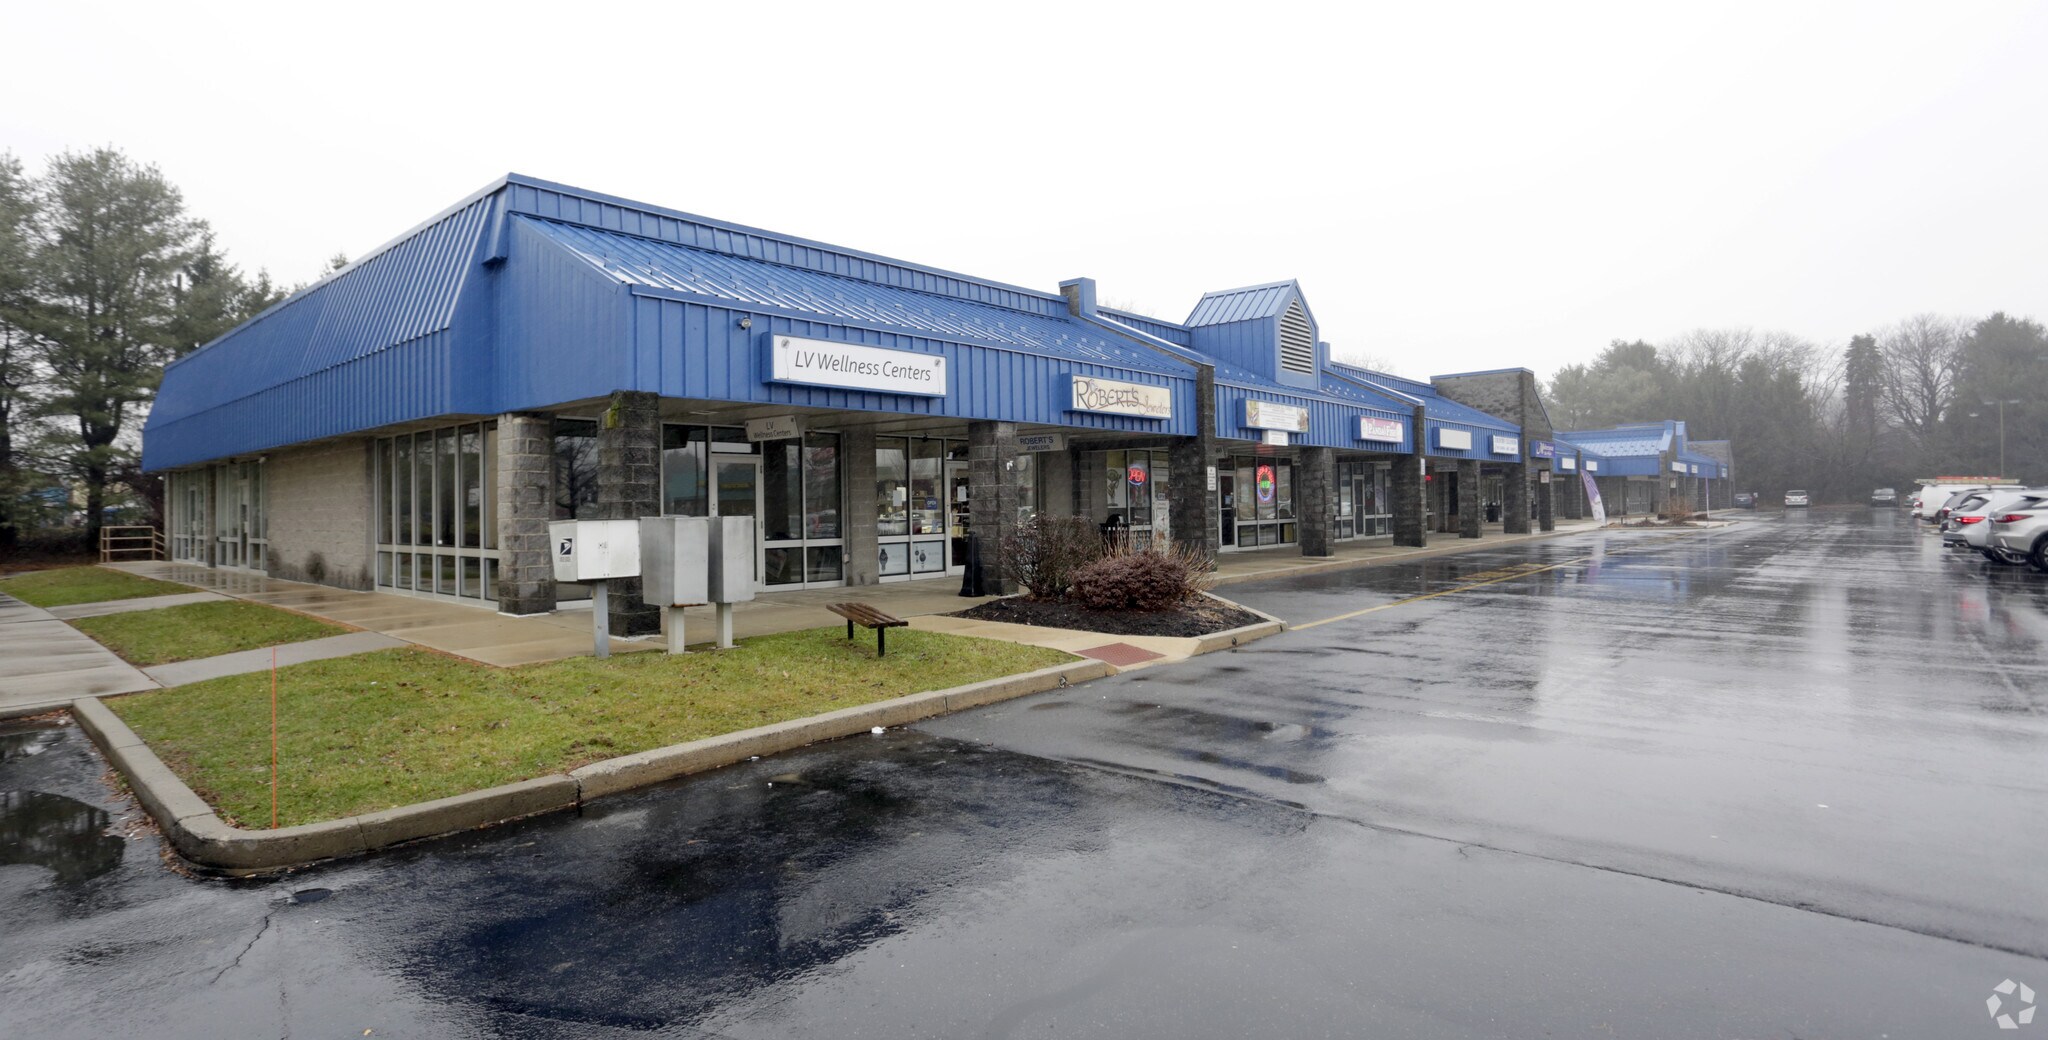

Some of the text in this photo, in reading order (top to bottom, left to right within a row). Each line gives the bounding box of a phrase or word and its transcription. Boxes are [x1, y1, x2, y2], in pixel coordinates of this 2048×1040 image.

[795, 350, 932, 382] LV Wellness Centers
[766, 421, 774, 430] LV
[753, 429, 792, 439] Wellness Centers
[1020, 435, 1054, 445] ROBERT'S
[1128, 468, 1146, 482] OPEN
